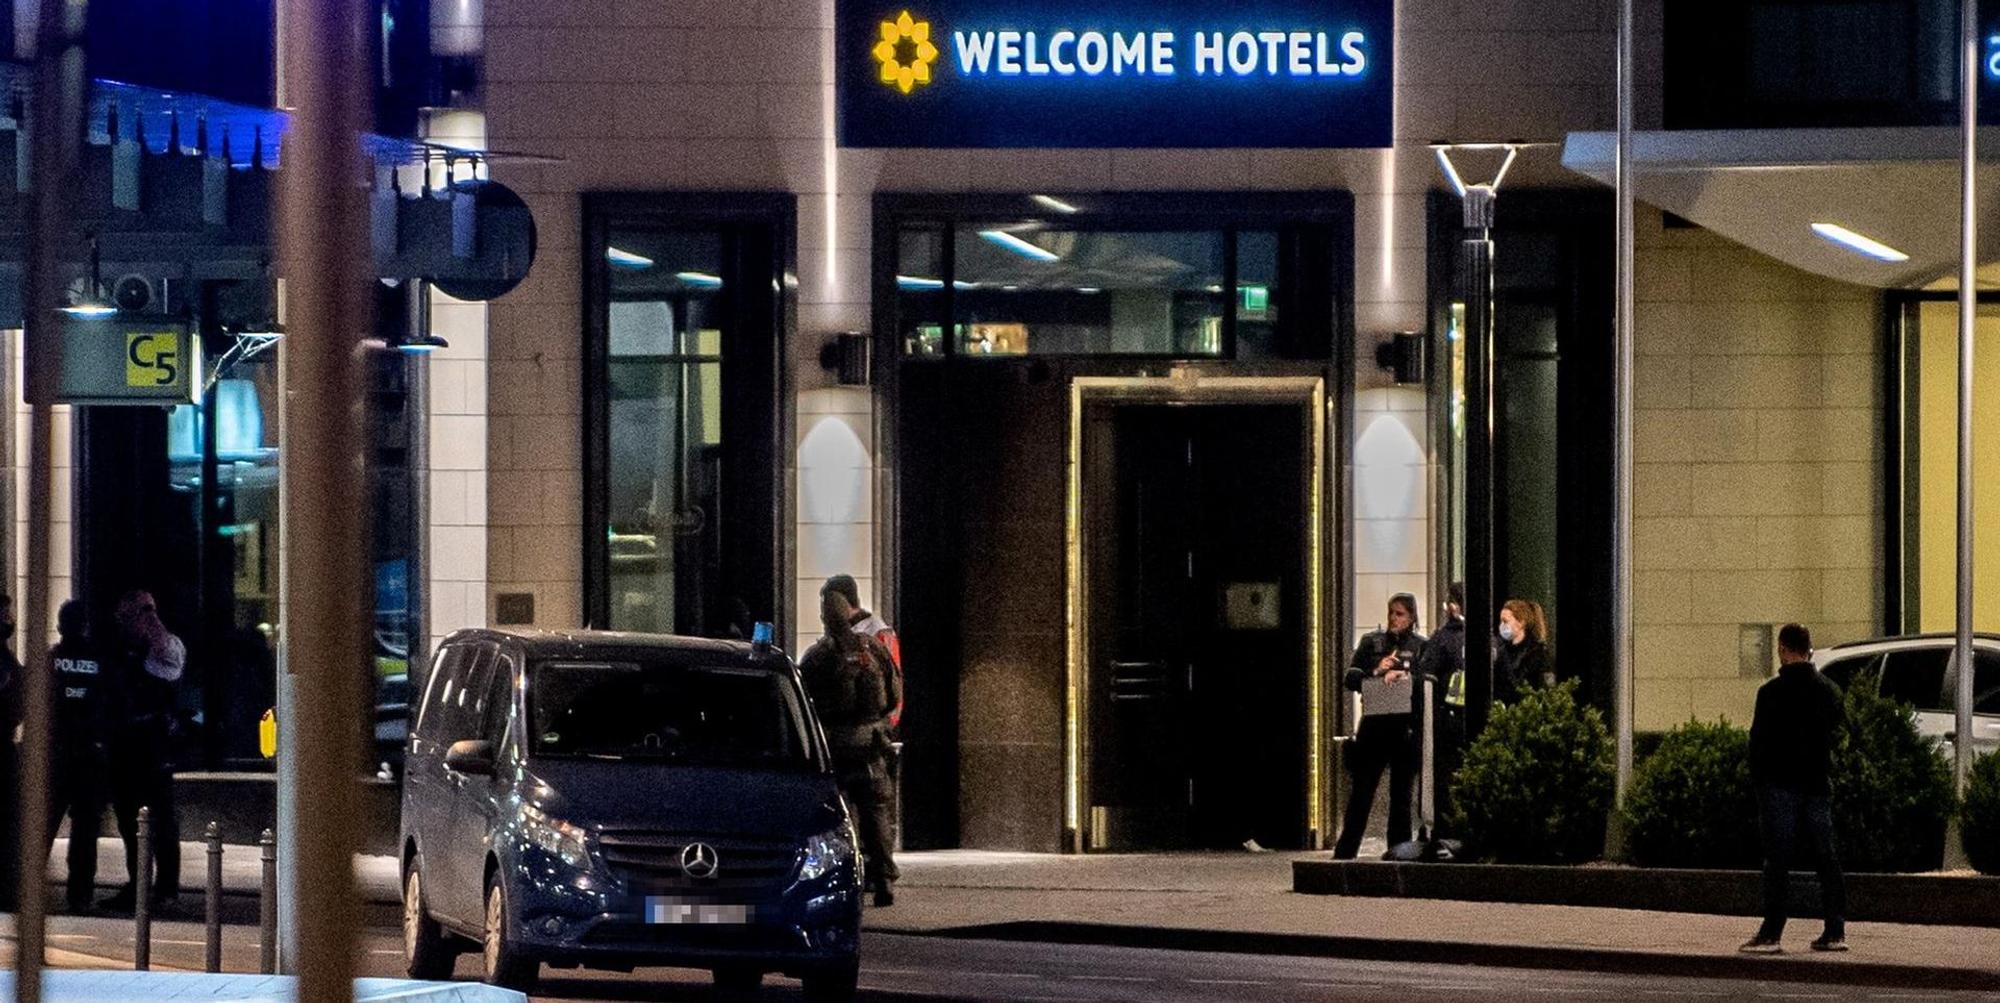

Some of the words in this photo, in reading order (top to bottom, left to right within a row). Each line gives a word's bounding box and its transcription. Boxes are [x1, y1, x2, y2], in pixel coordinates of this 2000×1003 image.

[954, 31, 1175, 75] WELCOME
[1195, 31, 1366, 76] HOTELS
[130, 335, 176, 384] C5
